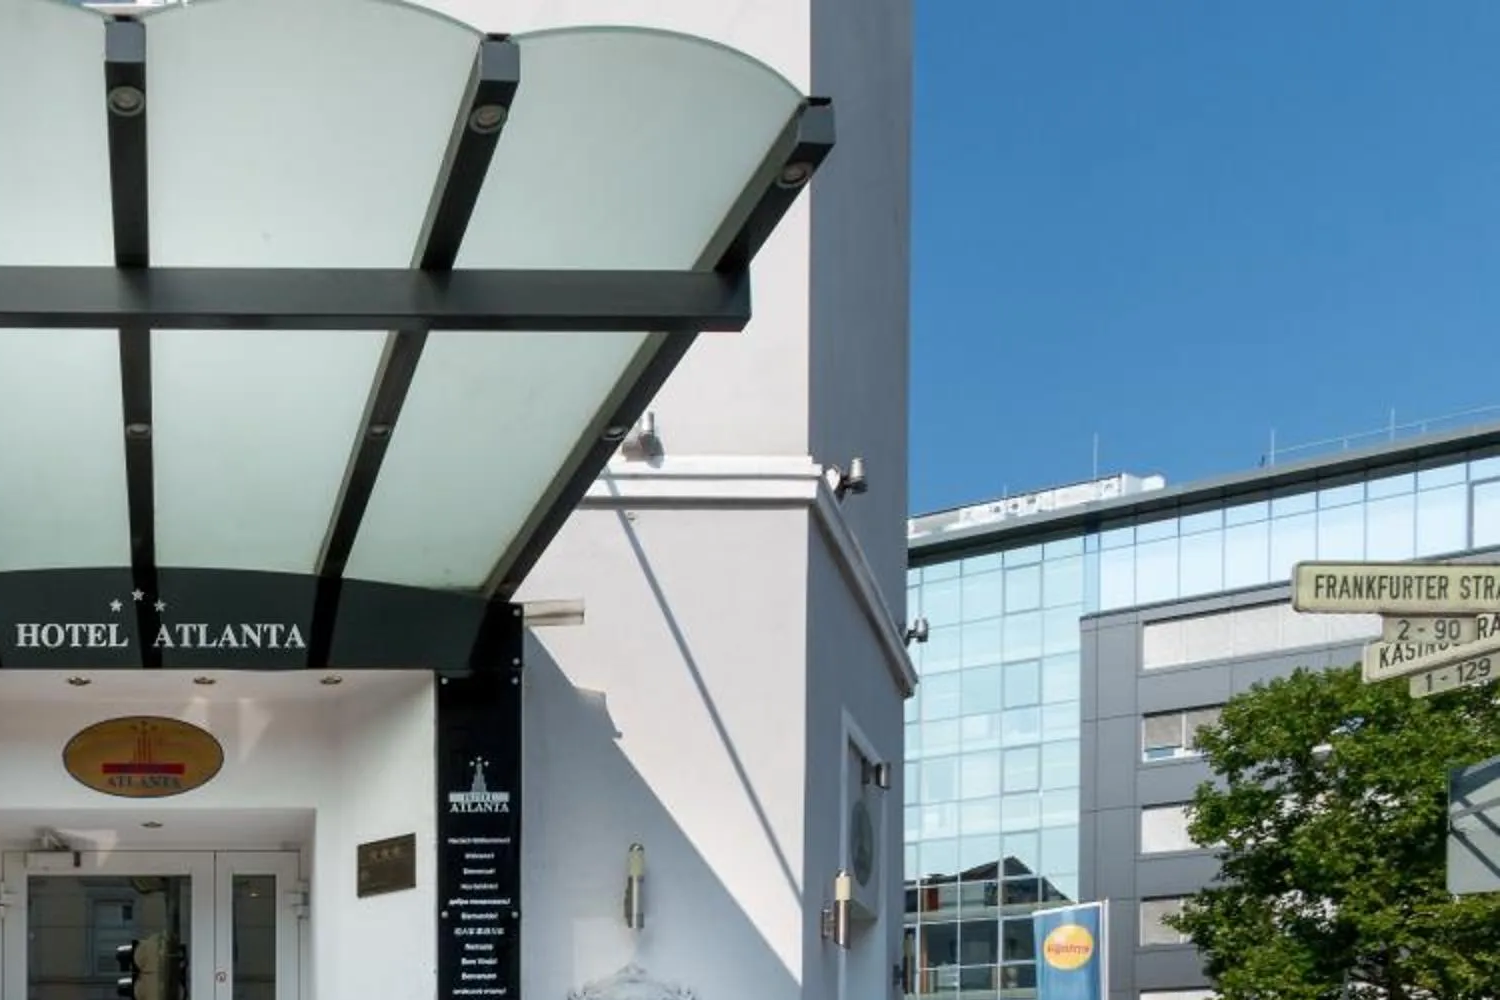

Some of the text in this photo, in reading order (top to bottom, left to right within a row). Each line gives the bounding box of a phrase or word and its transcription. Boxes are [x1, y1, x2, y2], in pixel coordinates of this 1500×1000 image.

[1314, 574, 1500, 600] FRANKFURTER STR
[15, 623, 307, 648] HOTEL ATLANTA
[1397, 619, 1410, 641] 2
[1434, 619, 1462, 641] 90
[1425, 673, 1433, 692] 1
[1456, 658, 1491, 684] 129
[107, 774, 183, 790] ATLANTA
[448, 802, 509, 813] ATLANTA
